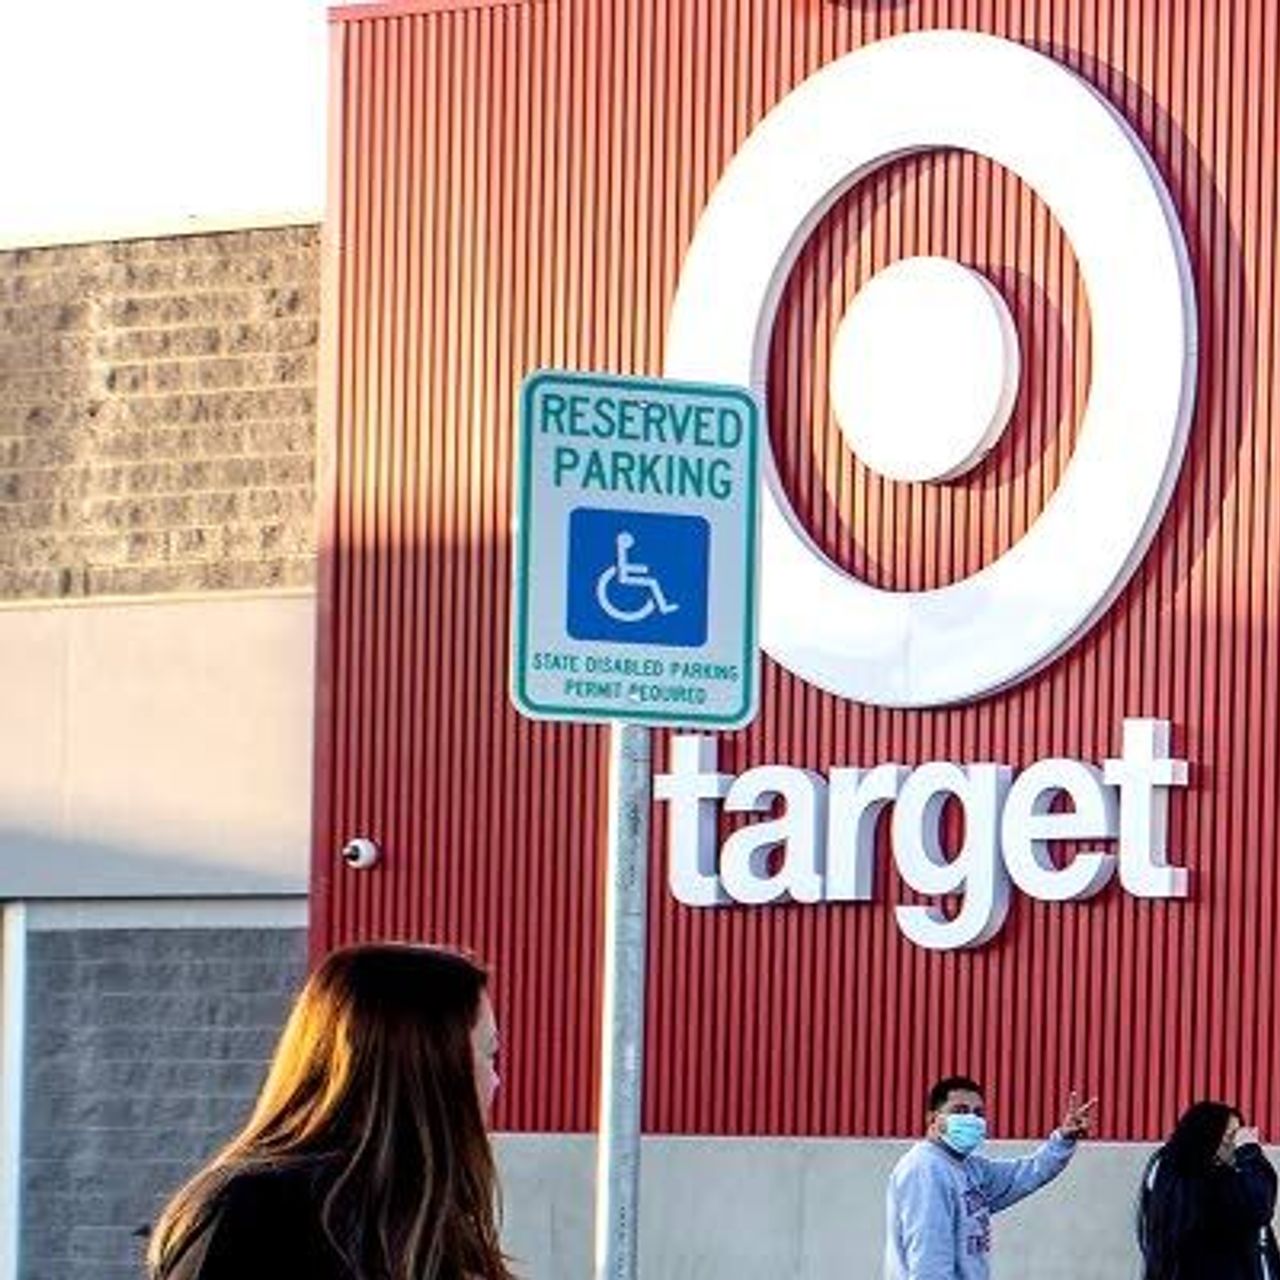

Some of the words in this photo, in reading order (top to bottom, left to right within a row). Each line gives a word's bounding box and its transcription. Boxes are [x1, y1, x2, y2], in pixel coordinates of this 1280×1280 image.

[540, 394, 744, 450] RESERVED
[553, 447, 733, 500] PARKING
[532, 653, 580, 674] STATE
[586, 656, 664, 677] DISABLED
[669, 662, 740, 683] PARKING
[564, 679, 622, 699] PERMIT
[652, 717, 1190, 952] target
